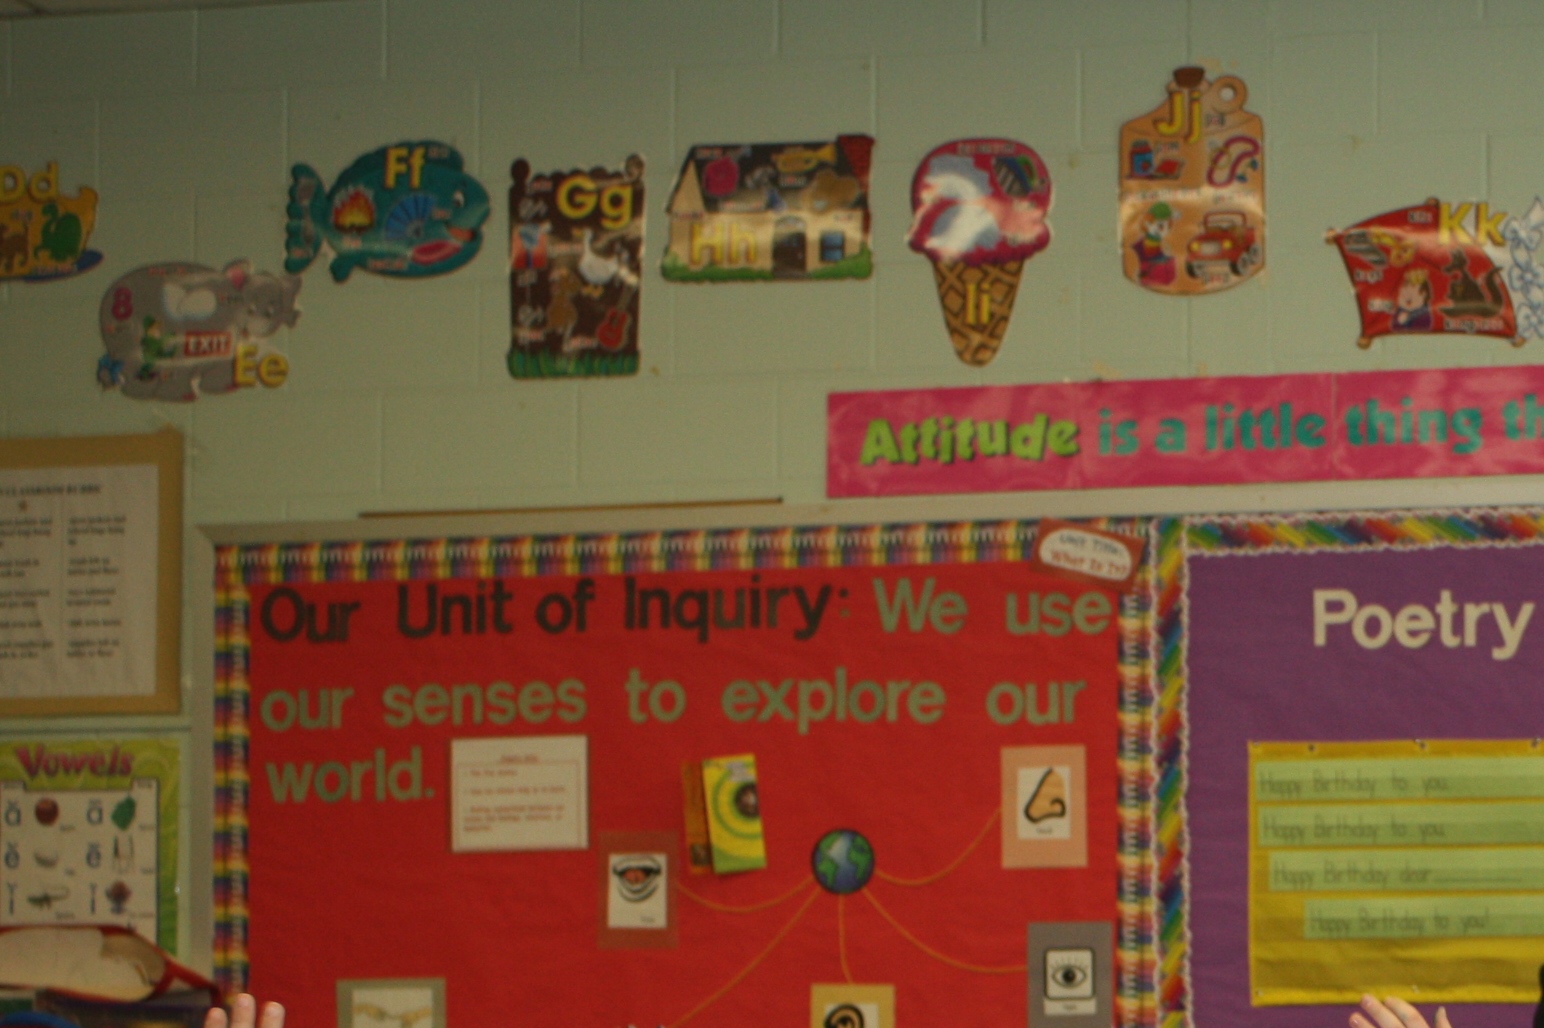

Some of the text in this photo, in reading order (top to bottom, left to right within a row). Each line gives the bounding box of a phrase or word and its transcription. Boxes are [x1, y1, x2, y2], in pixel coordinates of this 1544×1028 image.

[1154, 92, 1201, 143] Jj
[0, 160, 59, 200] Dd
[384, 147, 427, 189] Ff
[556, 176, 633, 229] Gg
[690, 222, 756, 264] Hh
[1439, 203, 1508, 246] Kk
[187, 334, 228, 353] EXIT
[235, 342, 289, 387] Ee
[859, 414, 1080, 467] Attitude
[1097, 409, 1140, 457] is
[1154, 417, 1189, 454] a
[1204, 403, 1327, 454] little
[1343, 397, 1484, 455] thing
[261, 574, 1112, 645] Our Unit of Inquiry: We use
[1312, 589, 1535, 661] Poetry
[261, 666, 1087, 736] our senses to explore our
[15, 744, 135, 781] Vowels
[265, 745, 436, 803] world.
[1259, 771, 1302, 795] Happy
[1313, 768, 1376, 796] Birthday
[1391, 770, 1408, 790] to
[1263, 816, 1304, 842] Happy
[1313, 814, 1378, 841] Birthday
[1391, 813, 1408, 837] to
[1272, 861, 1314, 888] Happy
[1323, 858, 1389, 888] Birthday
[1309, 908, 1353, 934] Happy
[1358, 906, 1425, 934] Birthday
[1432, 906, 1450, 928] to
